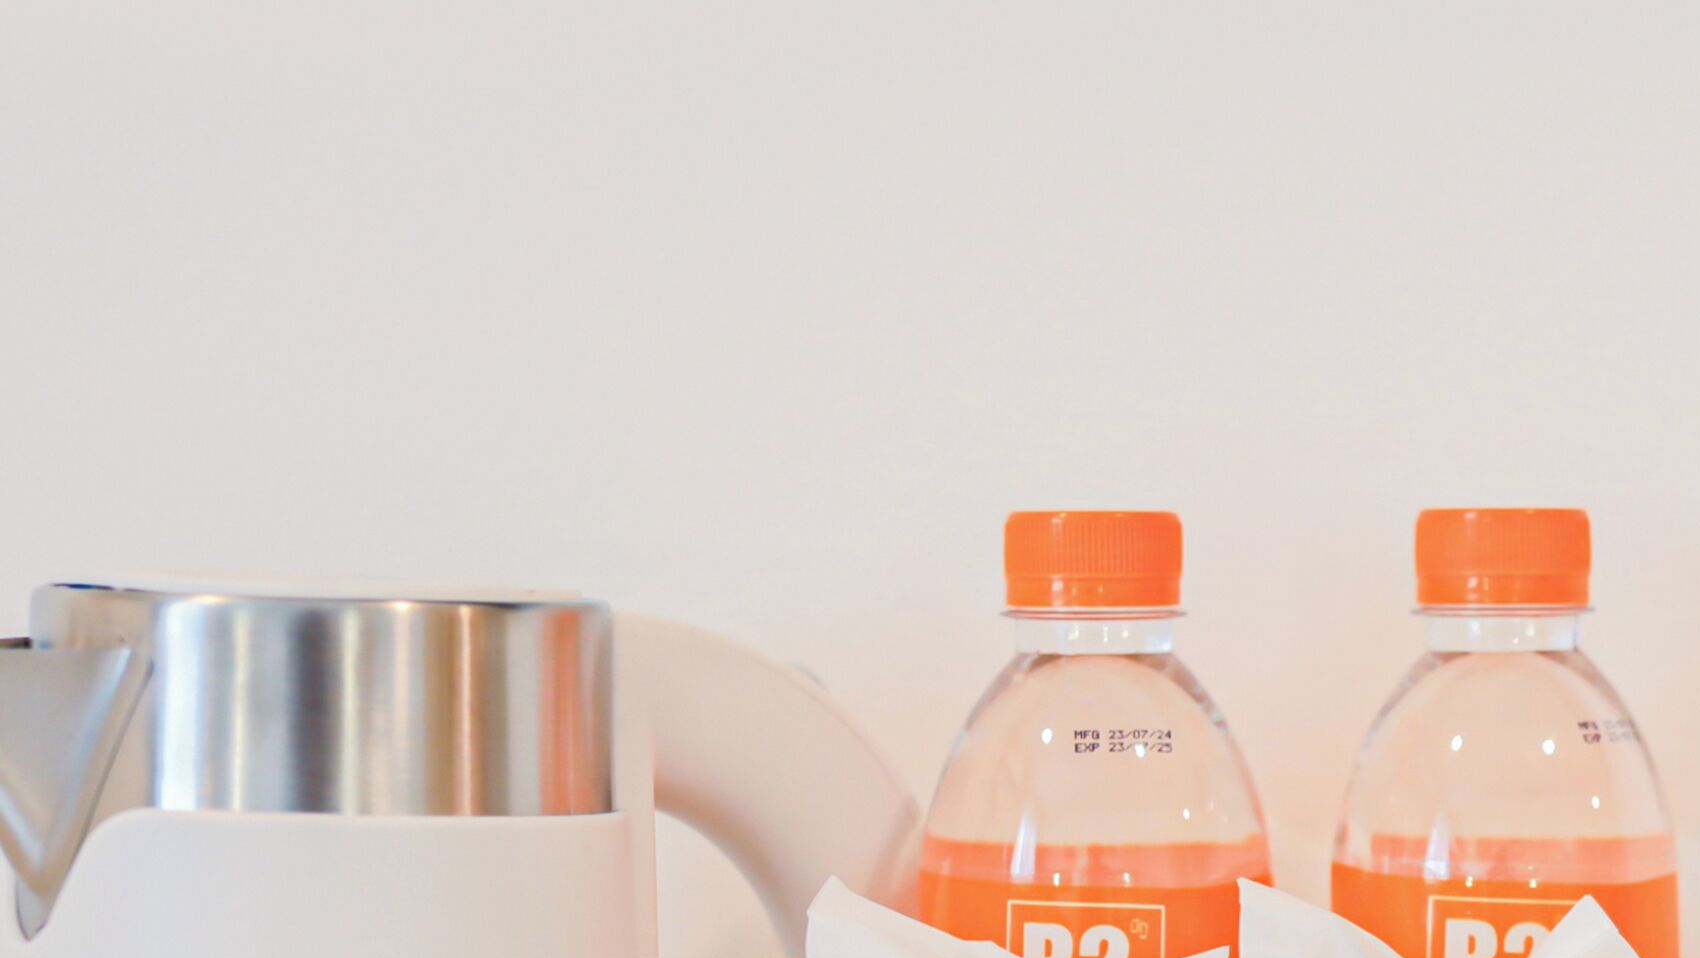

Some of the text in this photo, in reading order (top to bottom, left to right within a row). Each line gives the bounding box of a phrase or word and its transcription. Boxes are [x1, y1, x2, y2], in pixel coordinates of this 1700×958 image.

[1074, 729, 1172, 740] MFG 23/07/24
[1074, 742, 1173, 753] EXP 23//25
